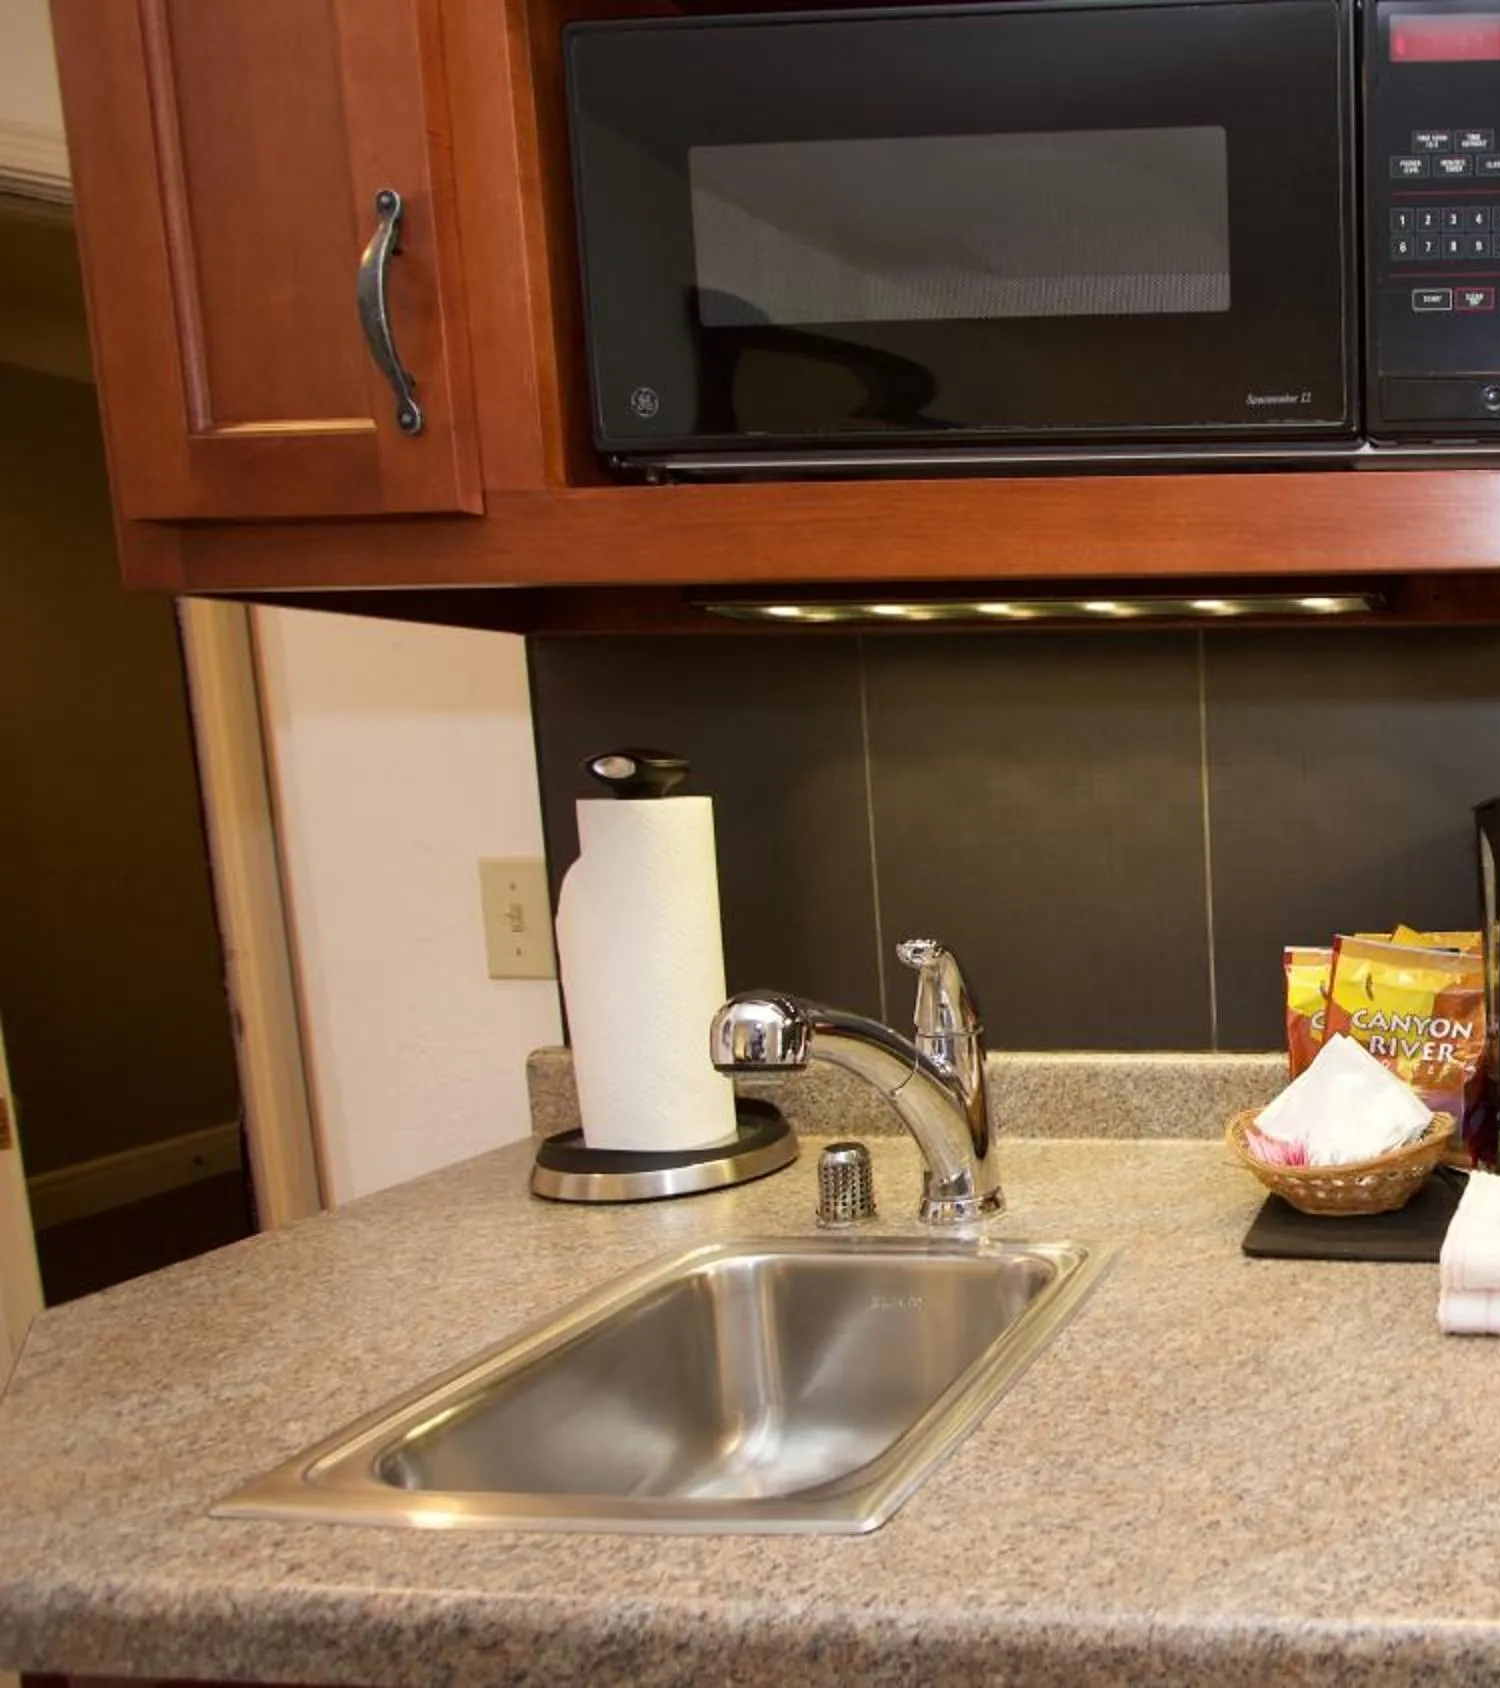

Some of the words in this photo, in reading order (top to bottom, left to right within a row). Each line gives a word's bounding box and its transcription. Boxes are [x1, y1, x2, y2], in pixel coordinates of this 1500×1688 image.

[1400, 215, 1406, 225] 1
[1424, 214, 1432, 226] 2
[1449, 214, 1457, 225] 3
[1475, 213, 1483, 224] 4
[1399, 241, 1407, 253] 6
[1424, 241, 1432, 252] 7
[1475, 240, 1483, 251] 9
[1351, 1008, 1473, 1039] CANYON
[1369, 1035, 1455, 1062] RIVER
